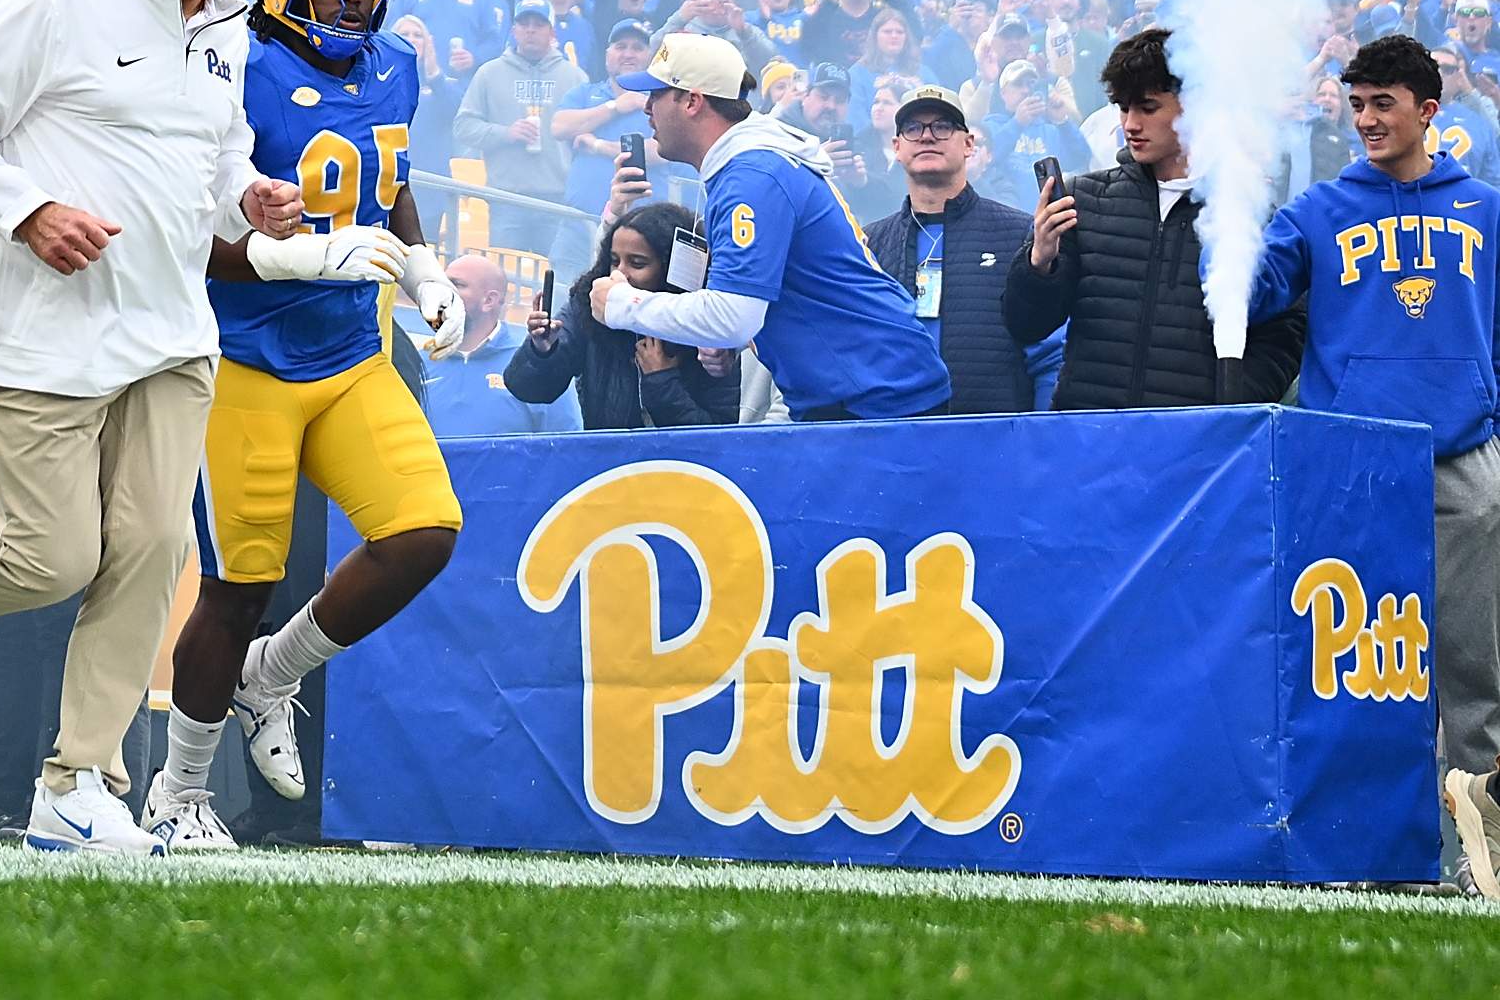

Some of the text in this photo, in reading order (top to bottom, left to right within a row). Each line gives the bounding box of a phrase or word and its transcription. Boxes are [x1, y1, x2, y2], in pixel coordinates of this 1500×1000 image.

[204, 47, 232, 83] Pitt
[296, 123, 409, 234] 95
[731, 203, 756, 249] 6
[1335, 215, 1483, 287] PITT
[517, 460, 1022, 836] Pitt
[1291, 557, 1431, 703] Pitt
